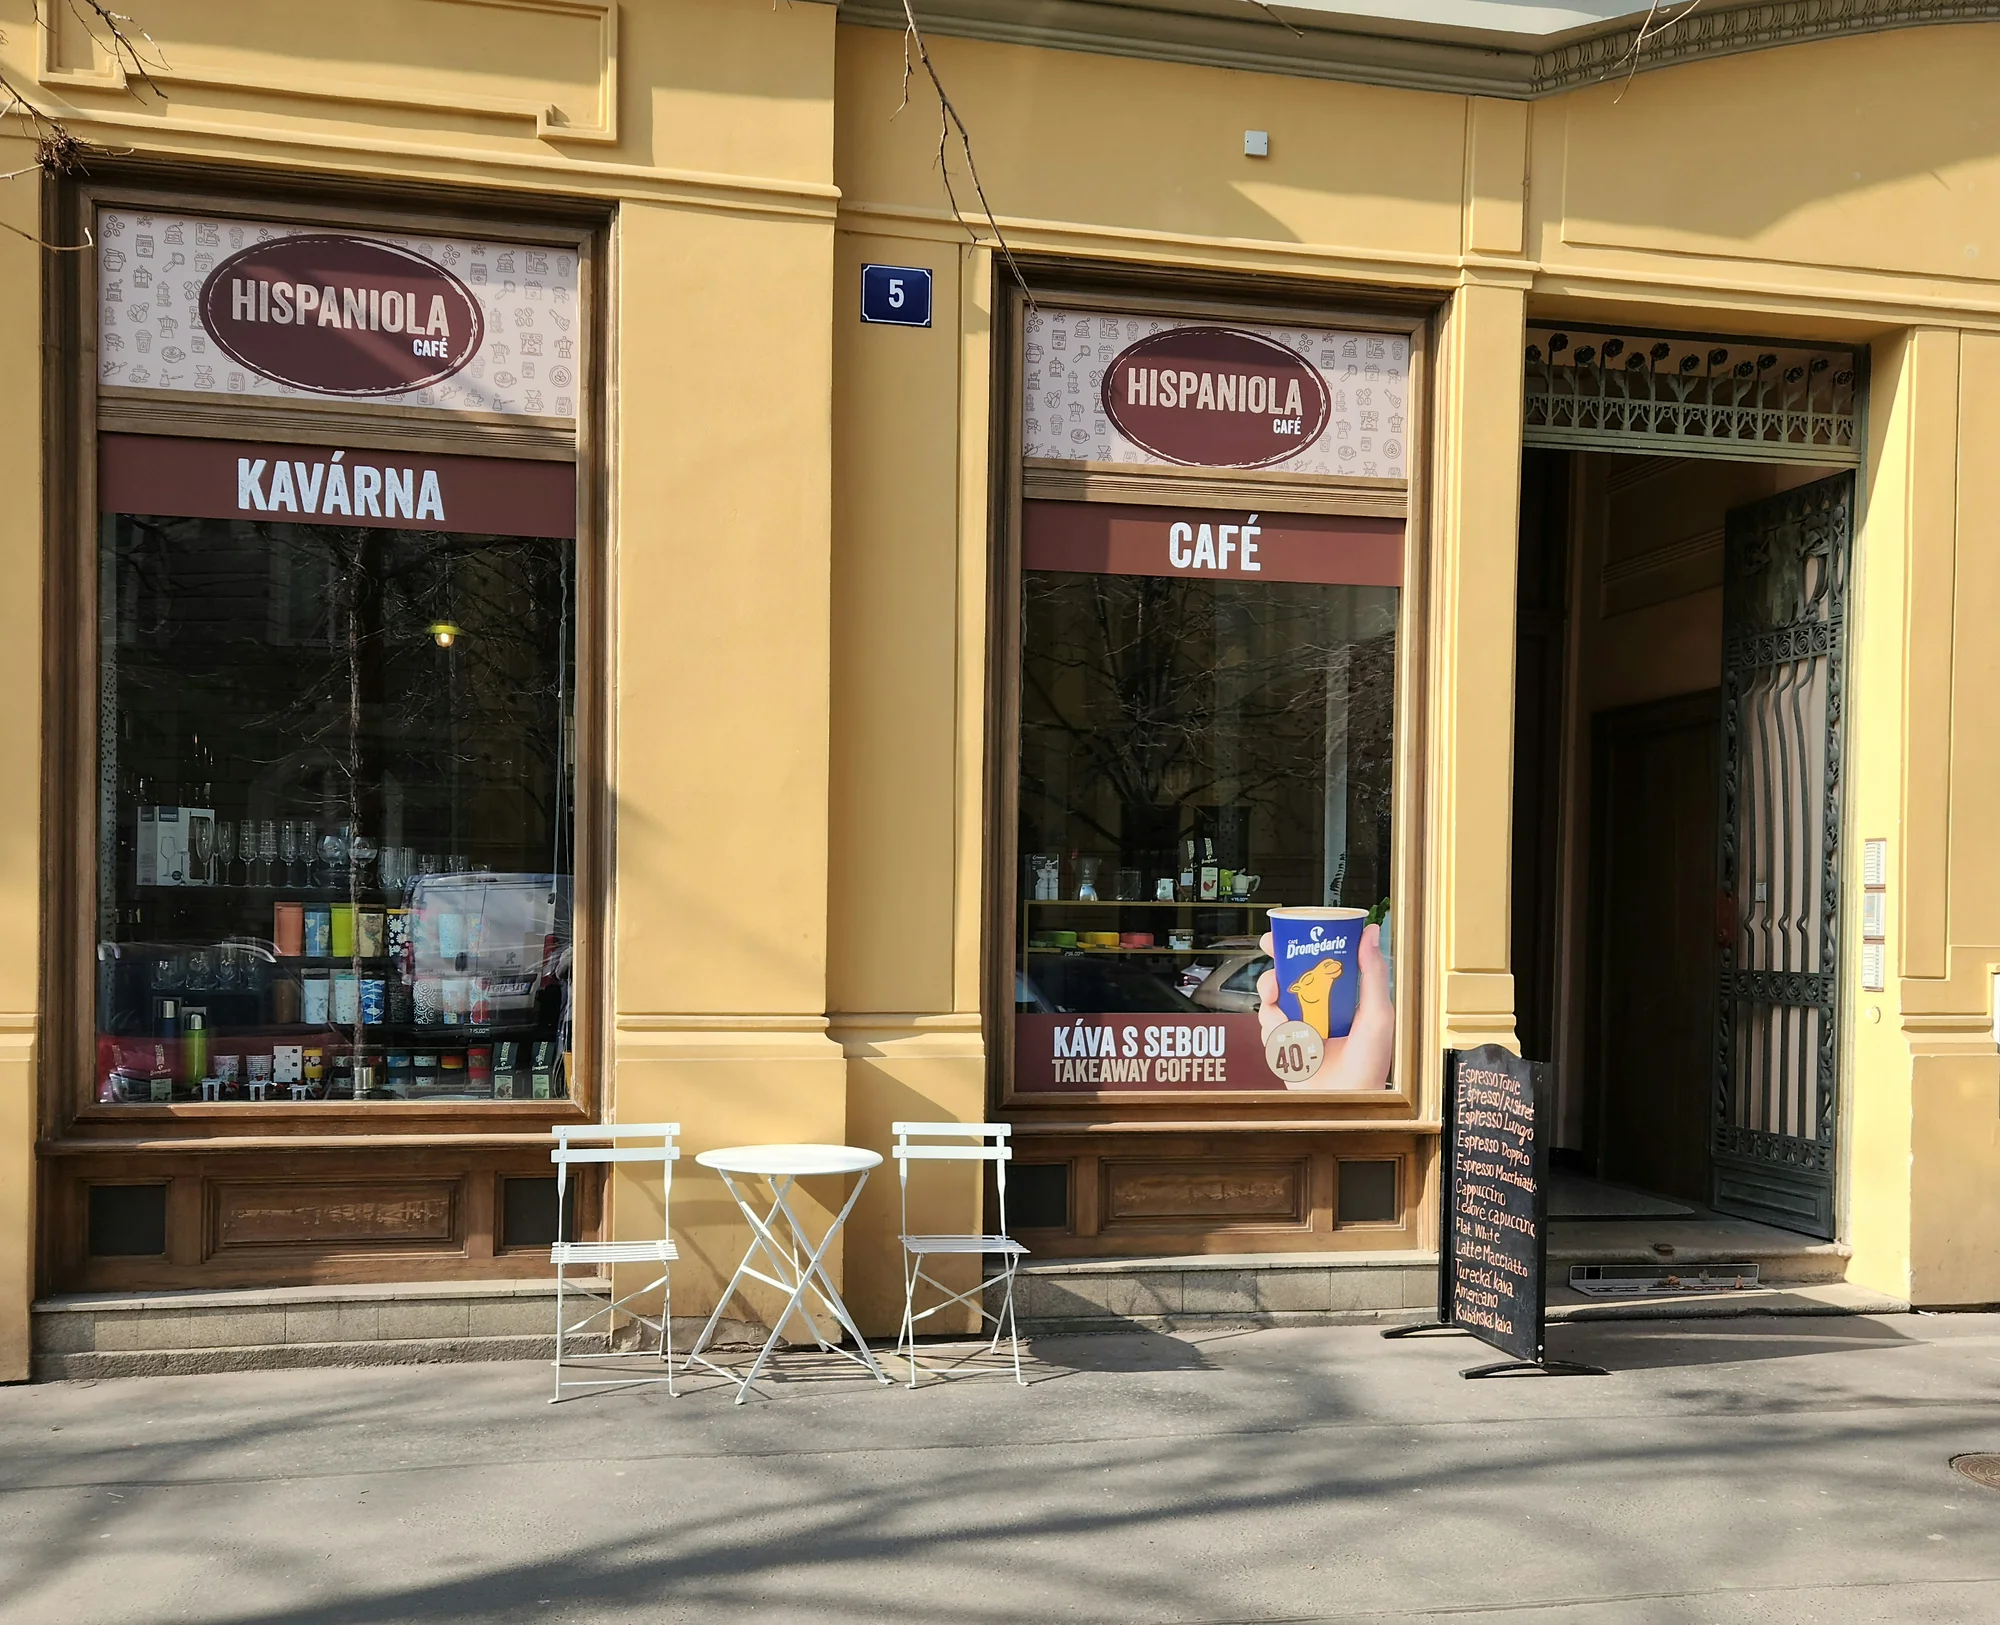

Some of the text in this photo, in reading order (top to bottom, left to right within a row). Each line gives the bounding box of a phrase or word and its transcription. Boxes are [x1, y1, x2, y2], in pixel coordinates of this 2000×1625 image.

[231, 278, 450, 337] HISPANIOLA
[888, 278, 905, 309] 5
[413, 337, 449, 359] CAFÉ
[1127, 367, 1303, 416] HISPANIOLA
[1273, 416, 1302, 435] CAFÉ
[237, 450, 445, 521] KAVÁRNA
[1169, 513, 1261, 572] CAFÉ
[1286, 936, 1347, 959] Dromedario
[1053, 1018, 1226, 1058] KÁVA S SEBOU
[1051, 1058, 1227, 1083] TAKEAWAY COFFEE
[1457, 1062, 1521, 1096] Espresso Tonic
[1457, 1104, 1534, 1146] Espresso Lungo
[1457, 1130, 1530, 1167] Espresso Doppio
[1456, 1153, 1495, 1180] Espresso
[1455, 1178, 1507, 1206] Cappuccino
[1456, 1216, 1501, 1245] Flat White
[1455, 1236, 1482, 1261] Latte
[1455, 1258, 1515, 1298] Turecká káva
[1454, 1281, 1499, 1309] Americano
